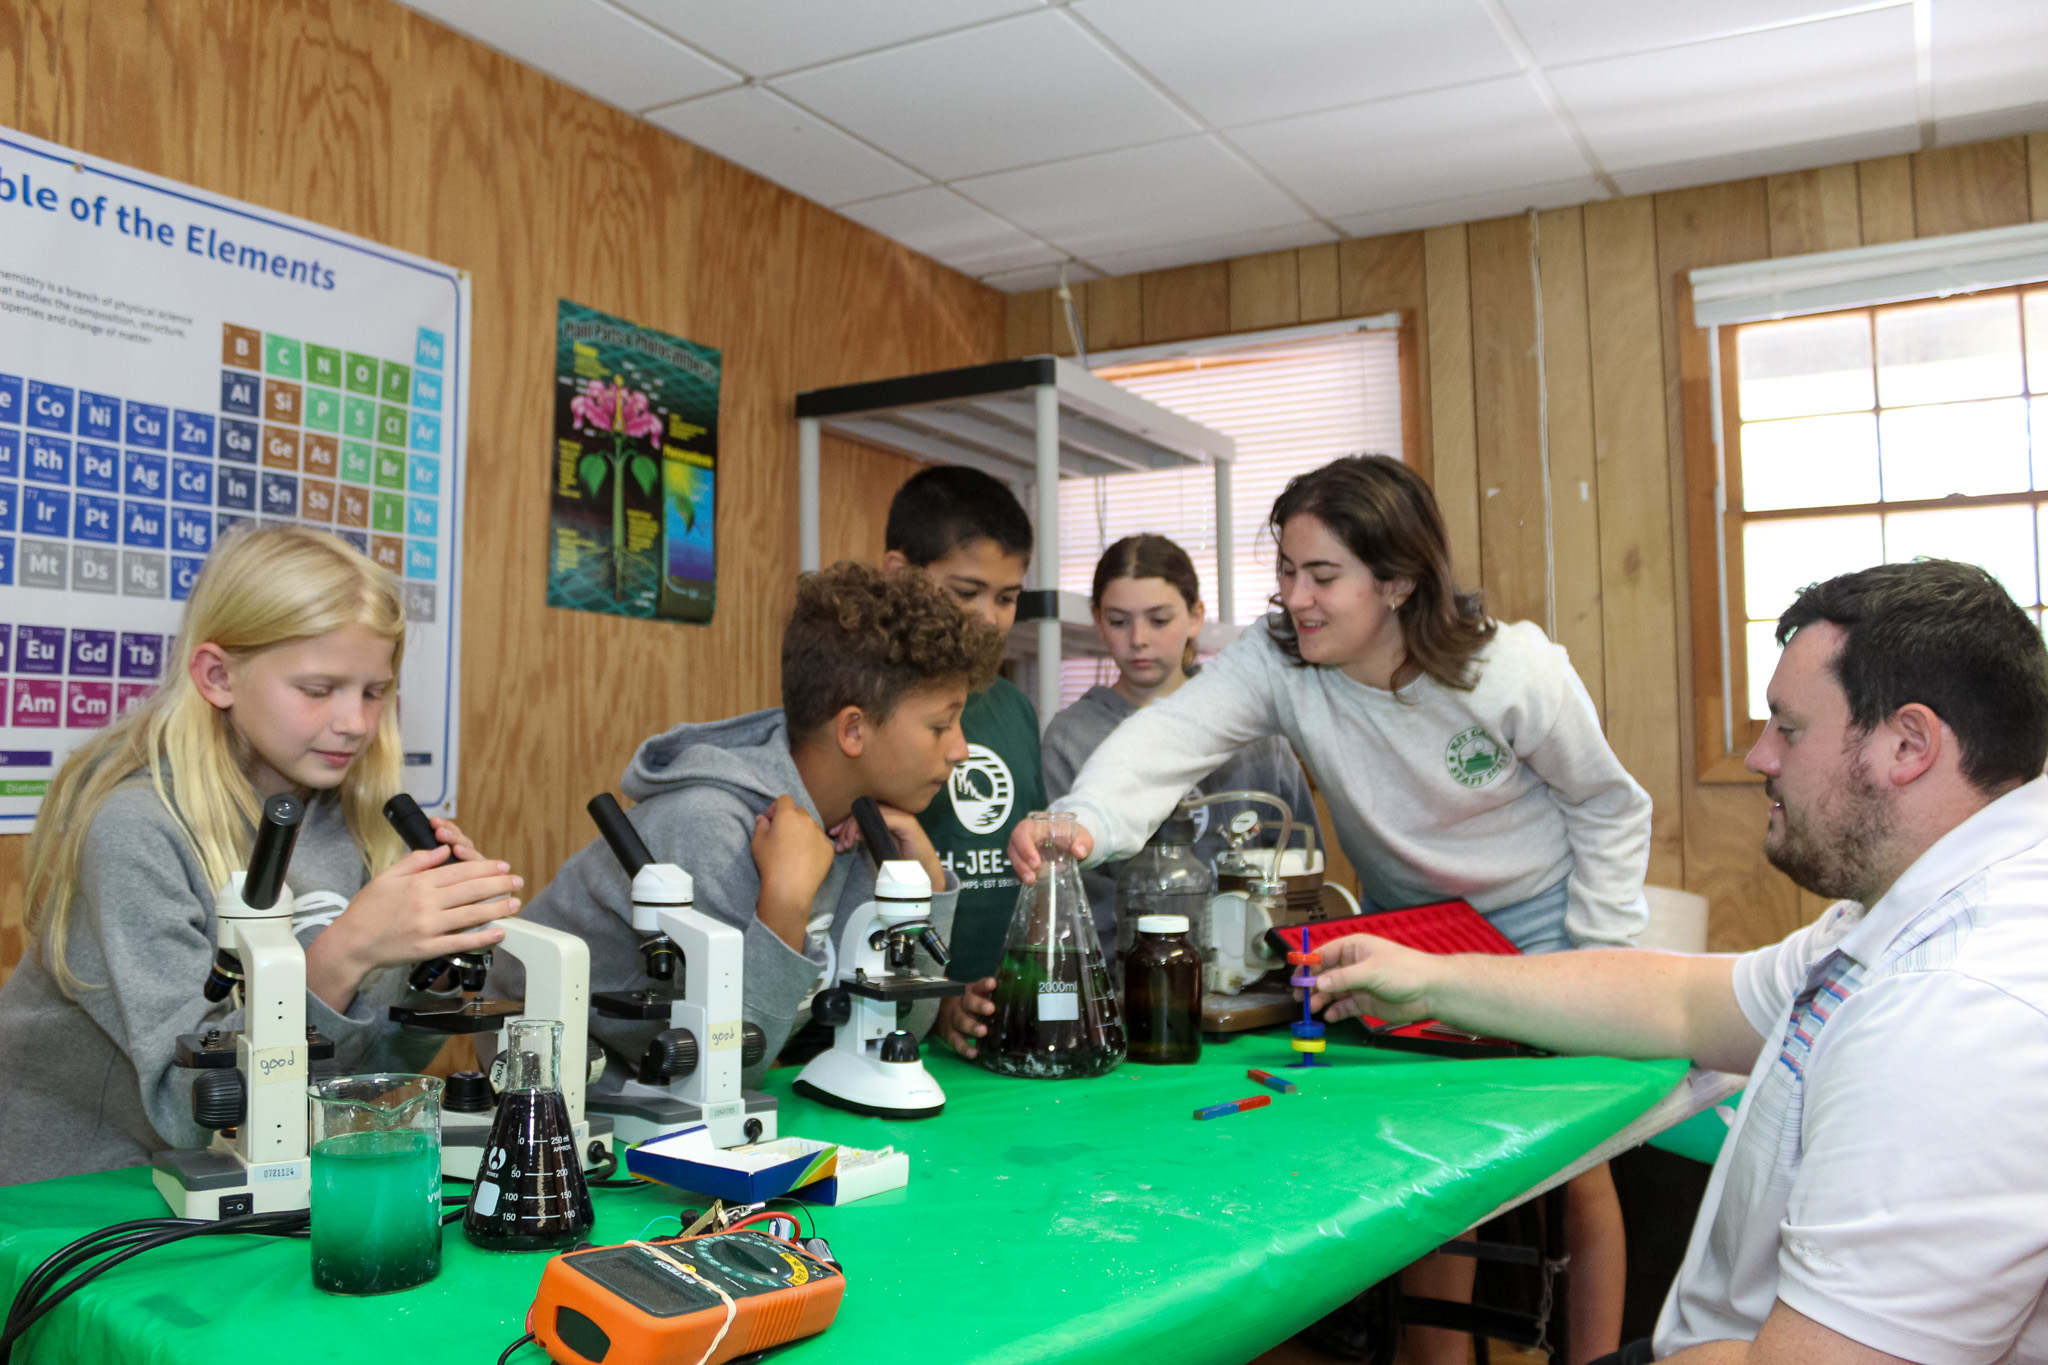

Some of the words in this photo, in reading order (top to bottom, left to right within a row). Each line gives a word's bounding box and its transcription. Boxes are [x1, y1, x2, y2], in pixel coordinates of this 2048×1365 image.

[70, 195, 108, 227] of
[116, 205, 175, 247] the
[187, 224, 335, 291] Elements
[0, 301, 45, 321] operties
[235, 338, 249, 356] B
[278, 348, 291, 366] C
[419, 339, 440, 360] He
[317, 356, 331, 375] N
[356, 366, 369, 383] O
[391, 374, 401, 390] F
[230, 384, 251, 405] Al
[275, 392, 293, 412] Si
[36, 395, 65, 418] Co
[89, 405, 111, 428] Ni
[317, 401, 329, 418] P
[133, 414, 160, 436] Cu
[354, 409, 365, 426] S
[385, 416, 400, 434] Cl
[181, 421, 207, 444] Zn
[226, 430, 252, 452] Ga
[416, 424, 434, 442] Ar
[269, 438, 294, 458] Ge
[310, 446, 331, 465] As
[34, 448, 63, 470] Rh
[85, 456, 112, 478] Pd
[347, 452, 366, 471] Se
[381, 459, 400, 478] Br
[132, 464, 159, 490] Ag
[179, 471, 206, 492] Cd
[415, 466, 434, 482] Kr
[227, 478, 248, 498] In
[267, 484, 292, 505] Sn
[308, 491, 329, 510] Sb
[345, 497, 363, 516] Te
[37, 501, 56, 521] Ir
[85, 508, 110, 530] Pt
[385, 504, 392, 520] I
[414, 508, 432, 526] Xe
[130, 514, 158, 535] Au
[178, 521, 206, 545] Hg
[30, 553, 58, 576] Mt
[378, 547, 397, 565] At
[411, 551, 432, 569] Rn
[83, 559, 108, 581] Ds
[131, 564, 159, 590] Rg
[27, 639, 55, 660] Eu
[78, 641, 107, 663] Gd
[127, 644, 154, 666] Tb
[17, 693, 56, 714] Am
[72, 695, 107, 715] Cm
[1038, 981, 1078, 993] 2000ml
[712, 1026, 735, 1046] good
[260, 1049, 295, 1075] good
[550, 1136, 563, 1145] 250
[511, 1170, 521, 1178] 50
[556, 1168, 568, 1177] 200
[560, 1191, 572, 1199] 150
[502, 1213, 516, 1222] 150
[564, 1210, 575, 1219] 100
